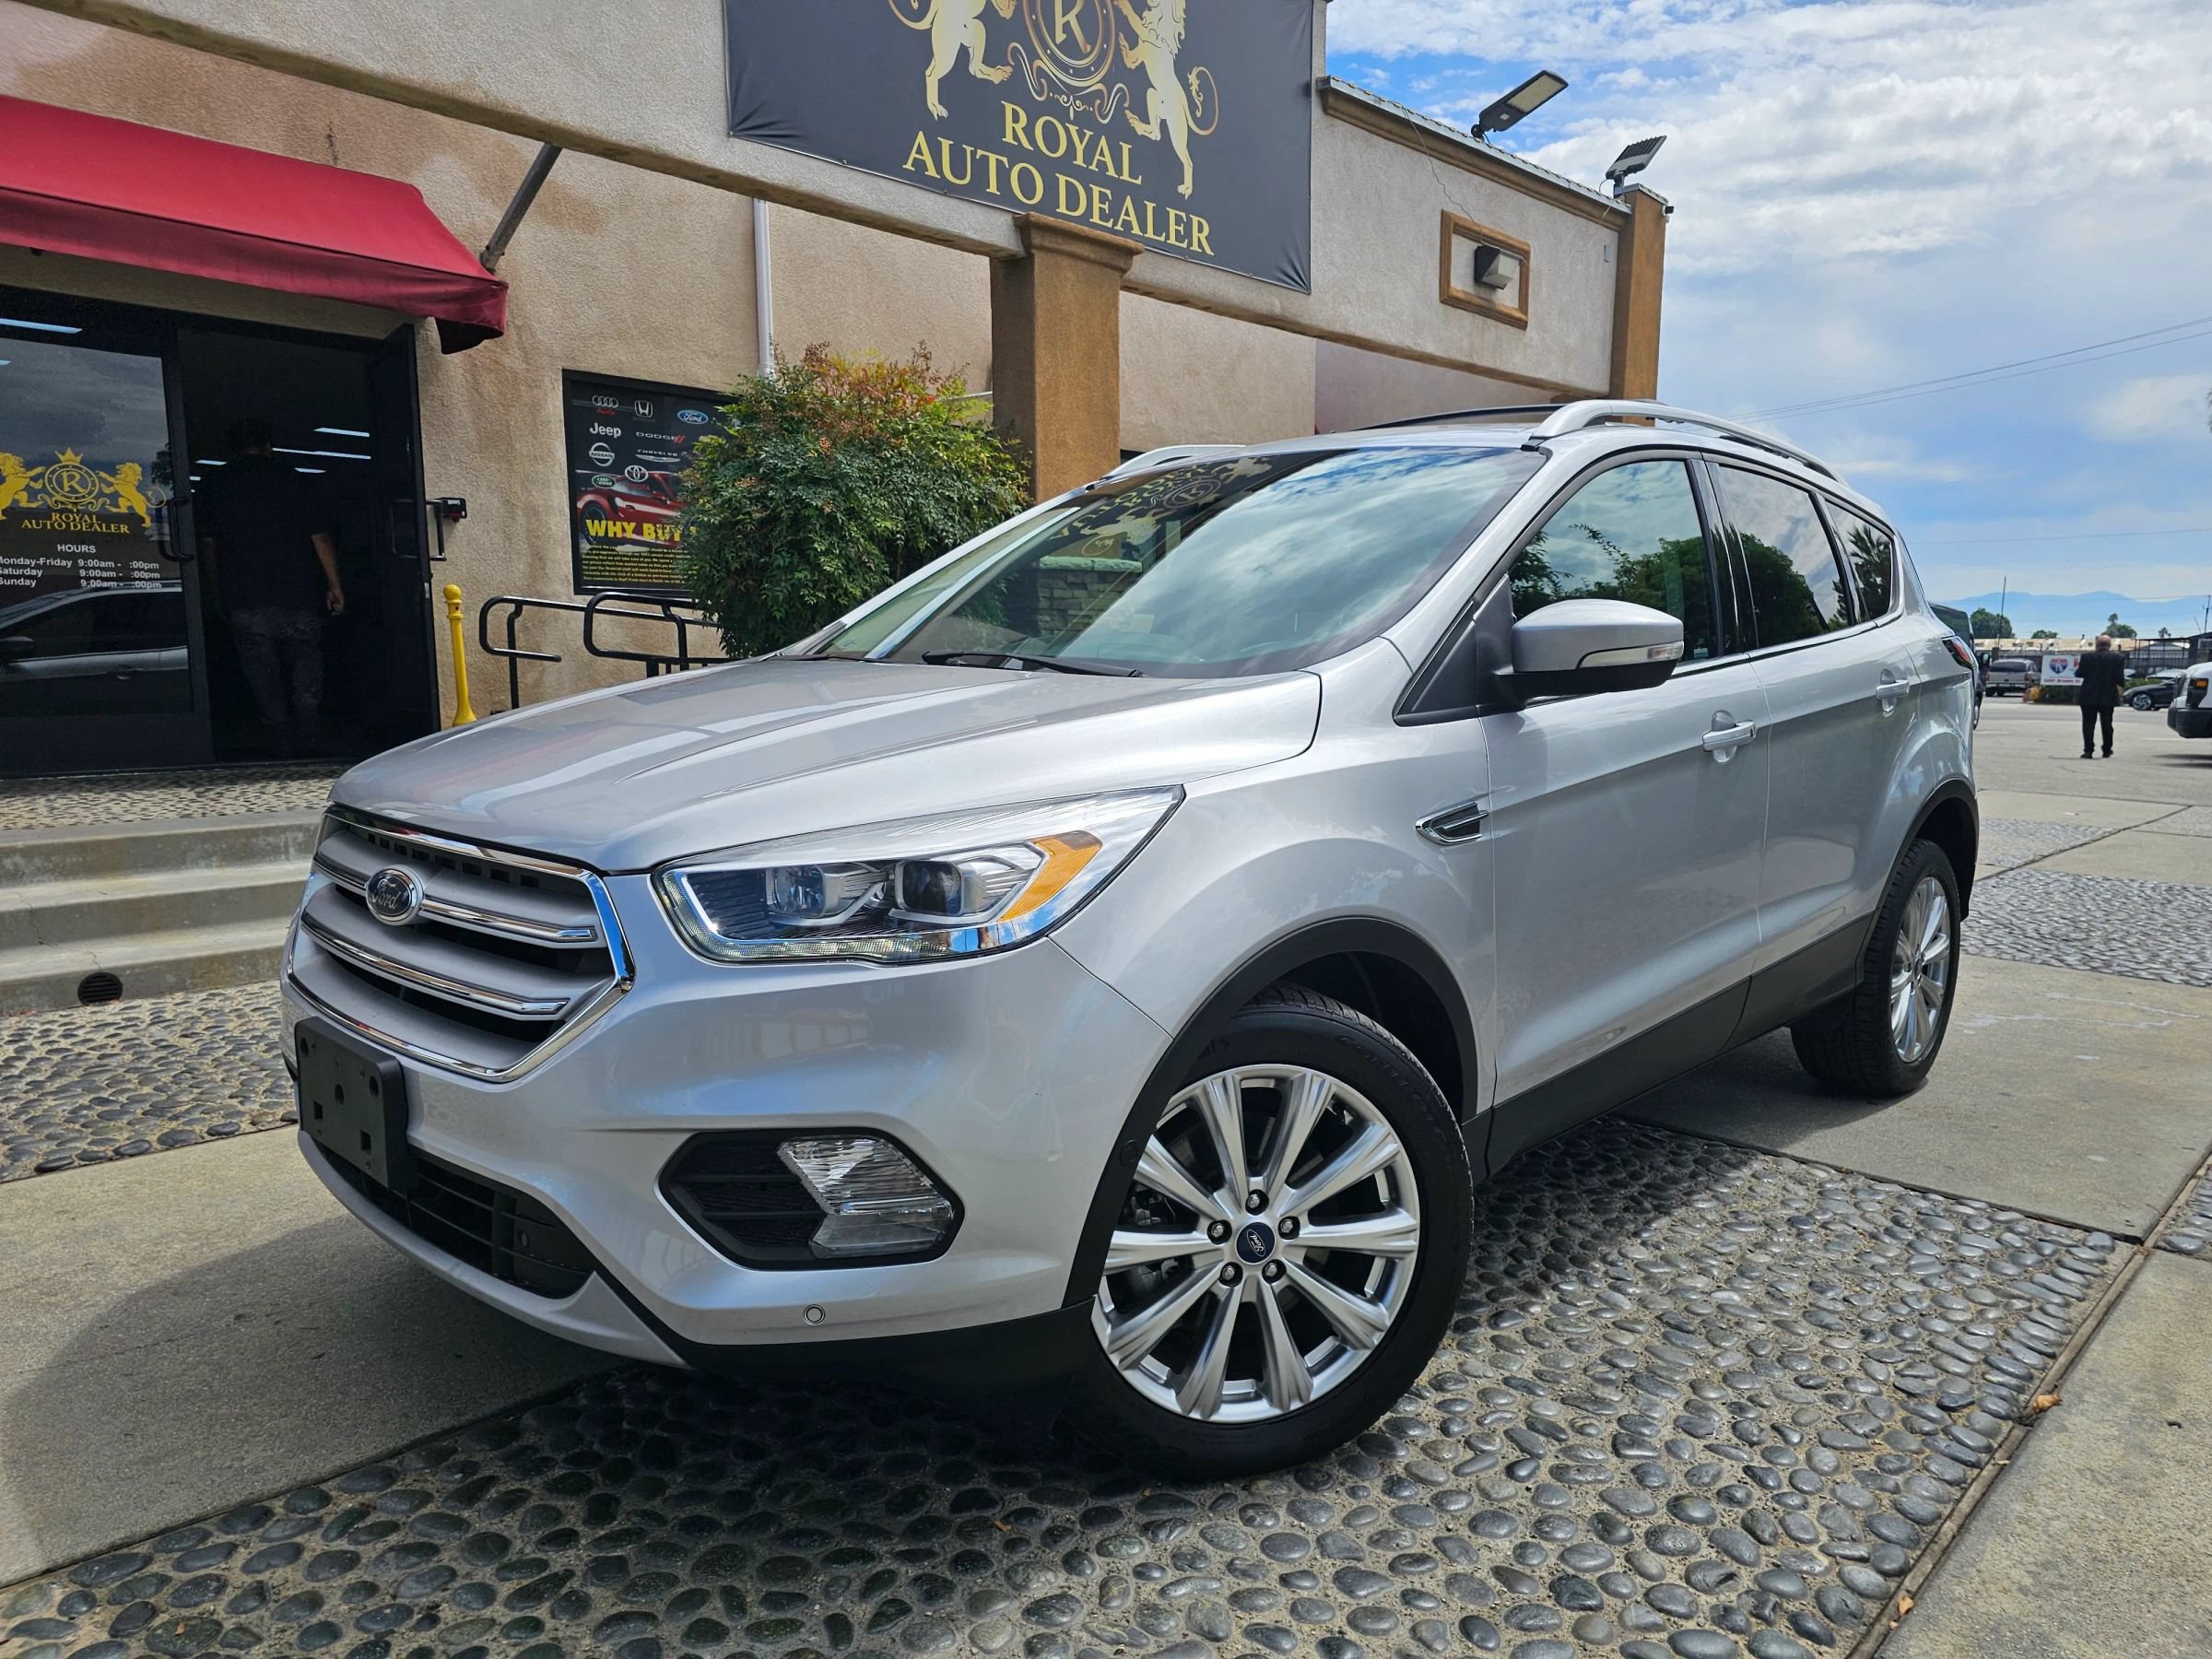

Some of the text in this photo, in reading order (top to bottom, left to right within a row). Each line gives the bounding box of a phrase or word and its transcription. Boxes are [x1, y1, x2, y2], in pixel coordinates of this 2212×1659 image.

[1000, 100, 1143, 185] ROYAL
[902, 130, 1216, 257] AUTO DEALER
[590, 422, 622, 439] Jeep
[61, 471, 86, 493] R
[21, 519, 131, 534] AUTO DEALER
[51, 512, 101, 524] ROYAL
[585, 519, 683, 542] WHY BUY
[57, 544, 97, 554] HOURS
[77, 559, 115, 569] 9:00am
[79, 569, 116, 578] 9:00am
[81, 579, 117, 588] 9:00am
[369, 878, 402, 911] Ford
[1249, 1234, 1265, 1253] Ford
